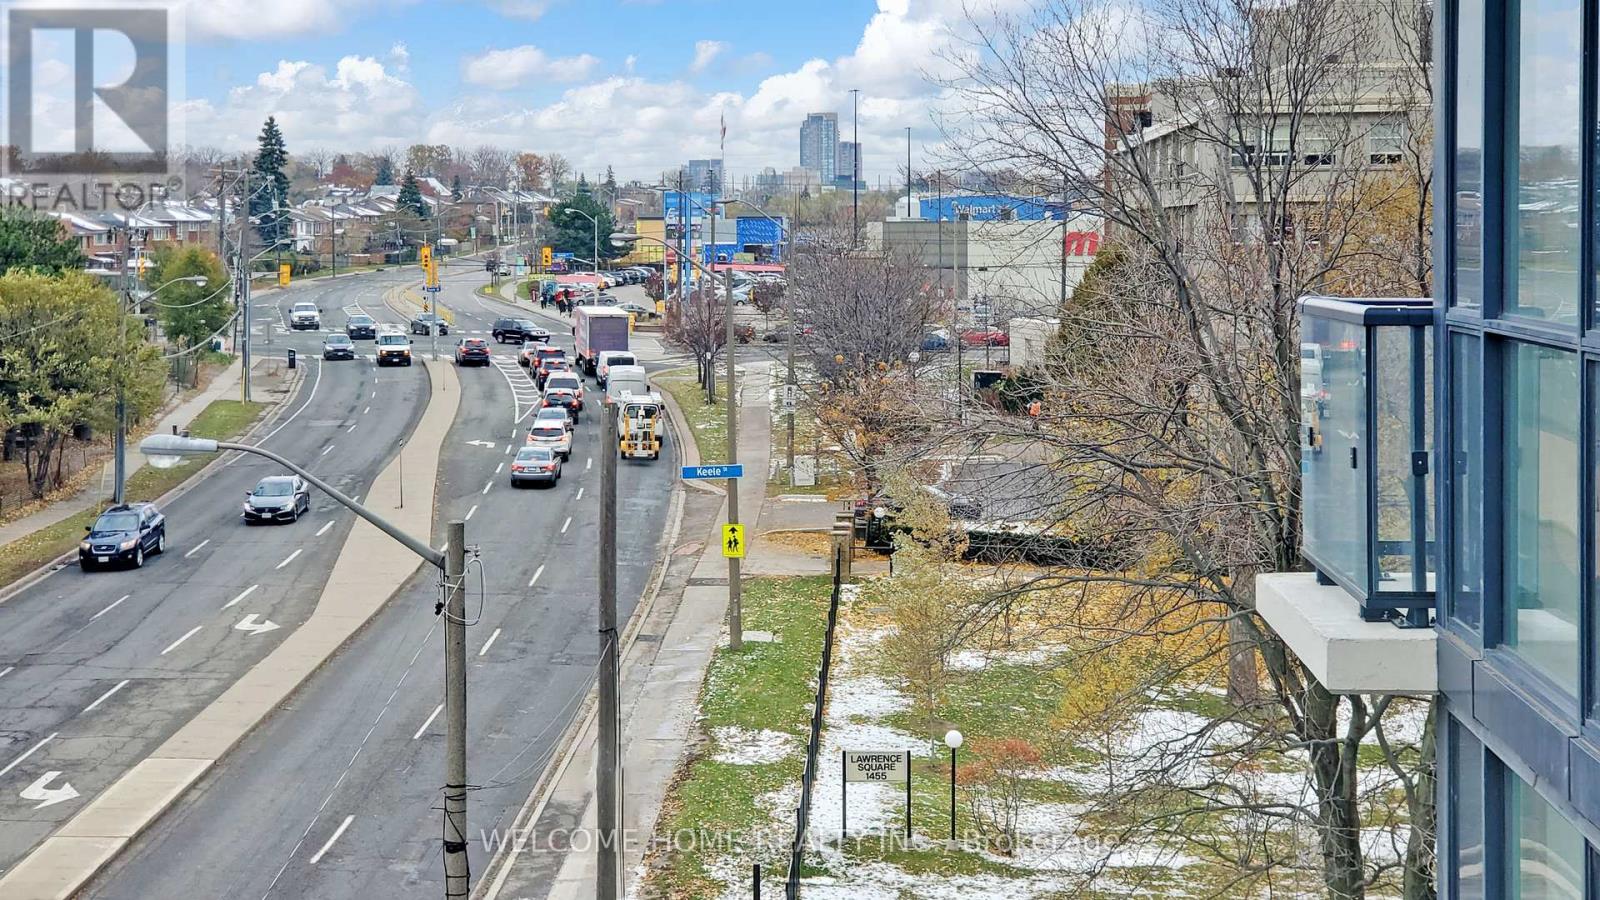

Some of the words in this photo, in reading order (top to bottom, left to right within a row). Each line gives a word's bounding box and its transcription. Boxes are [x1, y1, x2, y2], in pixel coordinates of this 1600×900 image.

[955, 204, 997, 215] Walmart
[697, 468, 721, 476] Keele
[850, 754, 903, 763] LAWRENCE
[857, 763, 897, 771] SQUARE
[866, 772, 887, 780] 1455
